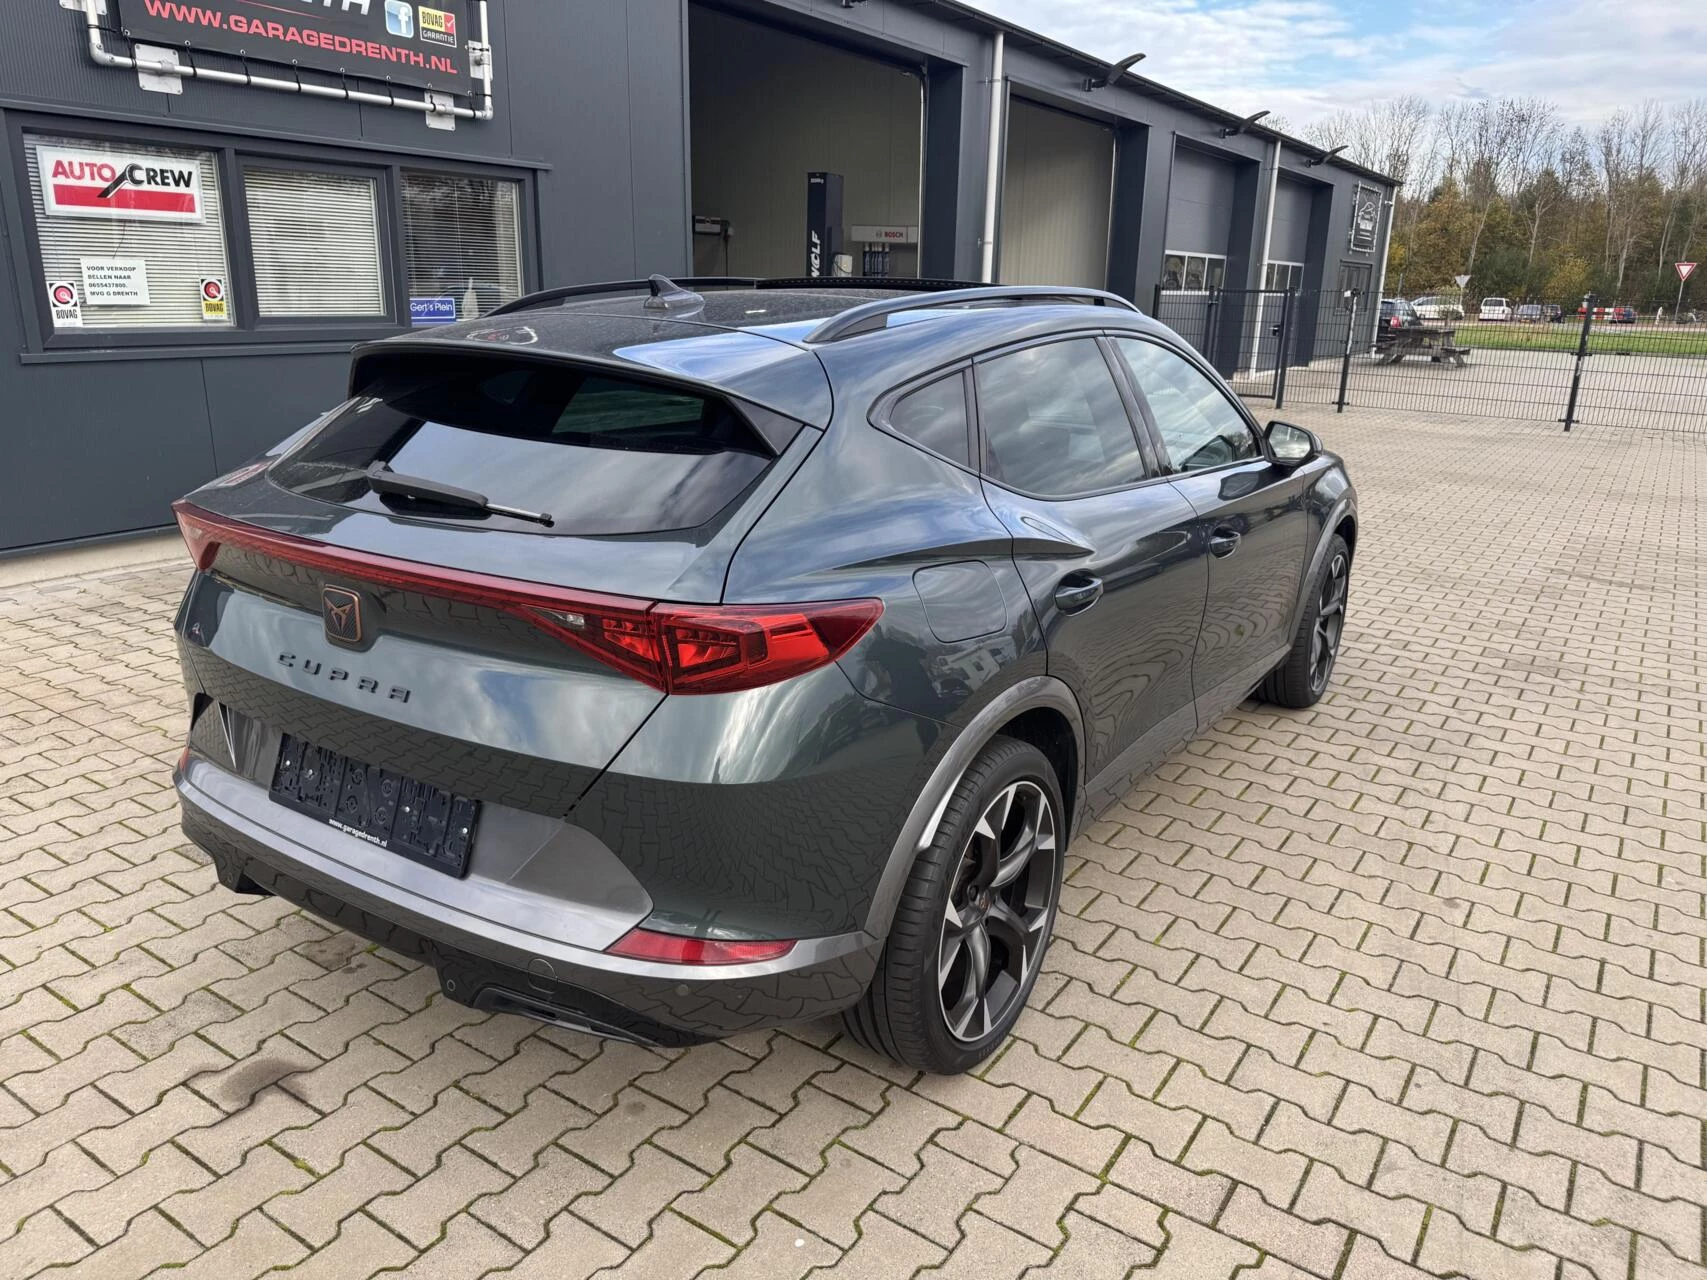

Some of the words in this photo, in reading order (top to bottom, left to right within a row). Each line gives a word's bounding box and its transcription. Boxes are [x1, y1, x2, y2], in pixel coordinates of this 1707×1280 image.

[421, 11, 443, 28] BOVAG
[144, 0, 457, 74] WWW.GARAGEDRENTH.NL
[422, 29, 454, 44] GARANTIE
[52, 159, 116, 182] AUTO
[127, 163, 192, 188] CREW
[56, 309, 78, 319] BOVAG
[205, 302, 224, 312] BOVAG
[434, 302, 453, 312] Plein
[278, 651, 411, 703] CUPRA
[329, 818, 388, 848] www.garagedrenth.nl
